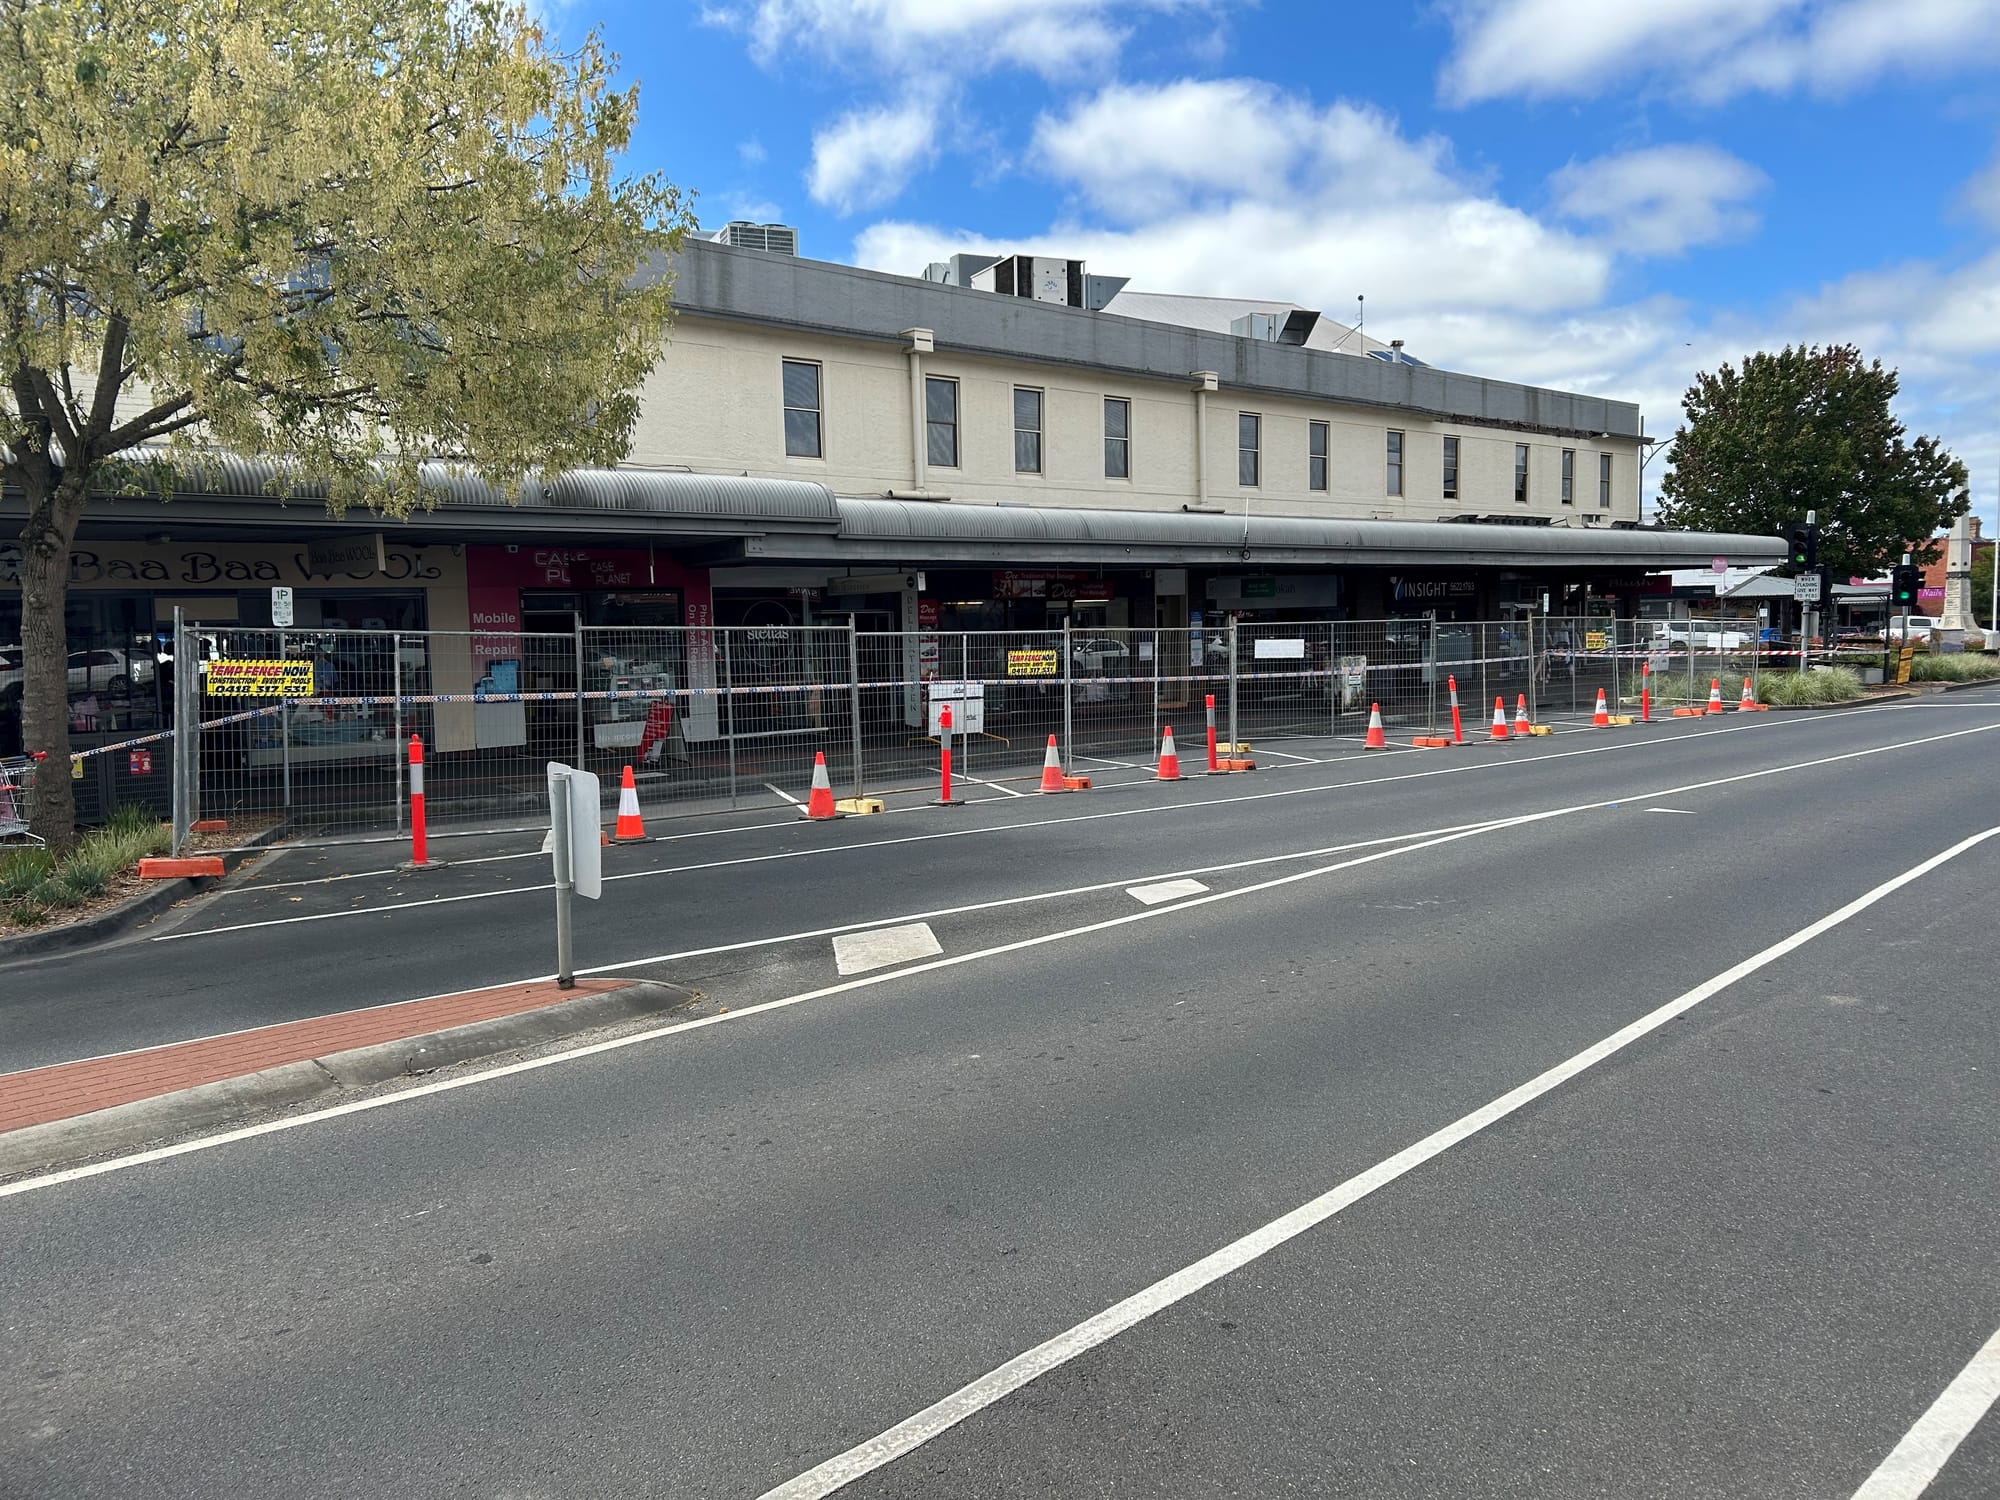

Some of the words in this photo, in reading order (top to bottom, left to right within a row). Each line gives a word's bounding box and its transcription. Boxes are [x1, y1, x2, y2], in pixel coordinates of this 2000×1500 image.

[67, 550, 170, 584] Baa
[181, 552, 281, 583] Baa
[591, 562, 615, 574] CASE
[596, 573, 631, 585] PLANET
[276, 589, 289, 600] 1P
[1405, 582, 1447, 597] INSIGHT
[688, 604, 696, 619] On
[473, 613, 516, 624] Mobile
[475, 645, 517, 657] Repair
[210, 665, 243, 676] TEMP
[244, 665, 282, 677] FENCE
[282, 666, 310, 676] NOW
[215, 685, 251, 693] 0418
[256, 685, 279, 693] 317
[283, 685, 308, 693] 531
[507, 693, 521, 701] SES
[541, 692, 554, 700] SES
